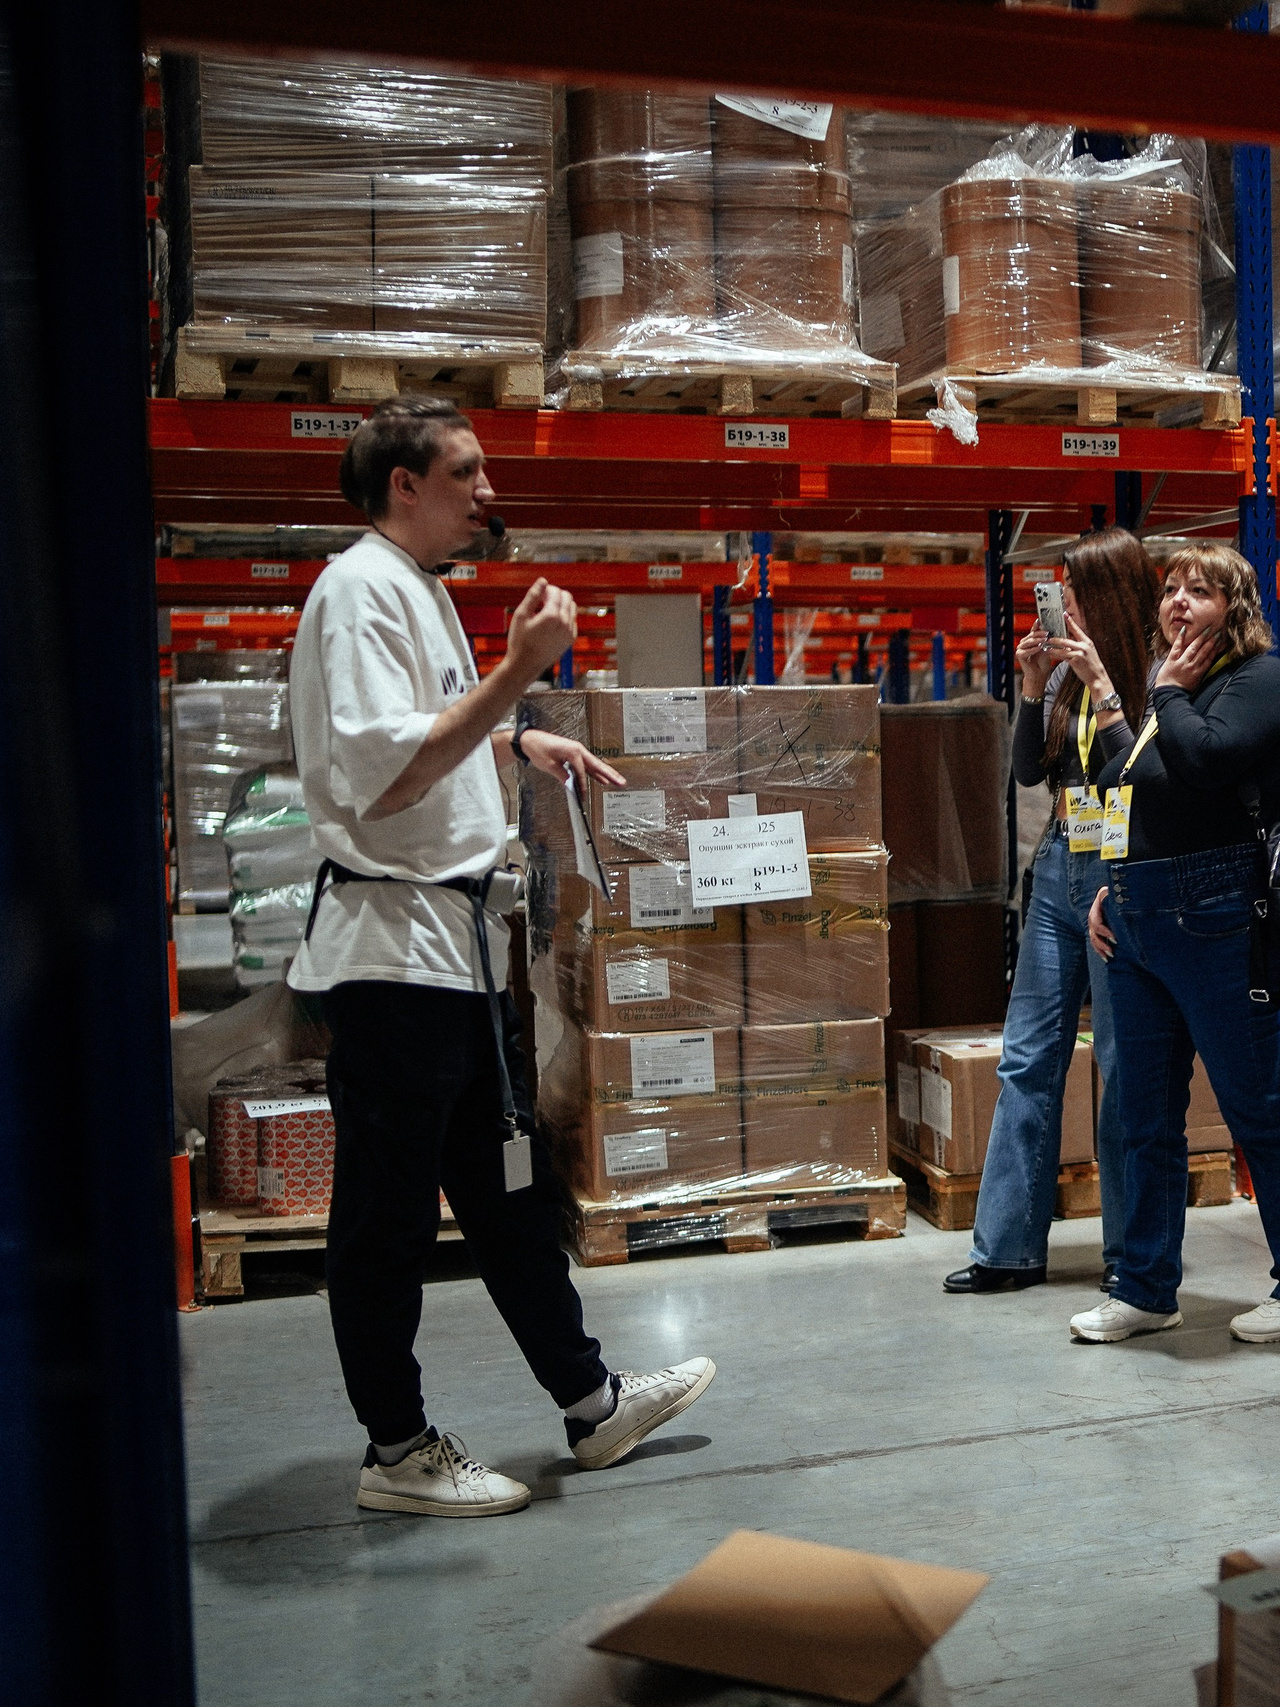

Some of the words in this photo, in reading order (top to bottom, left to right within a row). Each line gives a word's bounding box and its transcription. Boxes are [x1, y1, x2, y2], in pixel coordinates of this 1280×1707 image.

[293, 418, 360, 432] Б19-1-37
[727, 429, 787, 442] Б19-1-38
[1063, 438, 1117, 451] Б19-1-39
[770, 836, 794, 847] сухой
[753, 863, 798, 877] Б19-1-3
[697, 876, 718, 889] 360
[721, 877, 735, 887] кг
[754, 882, 762, 891] 8
